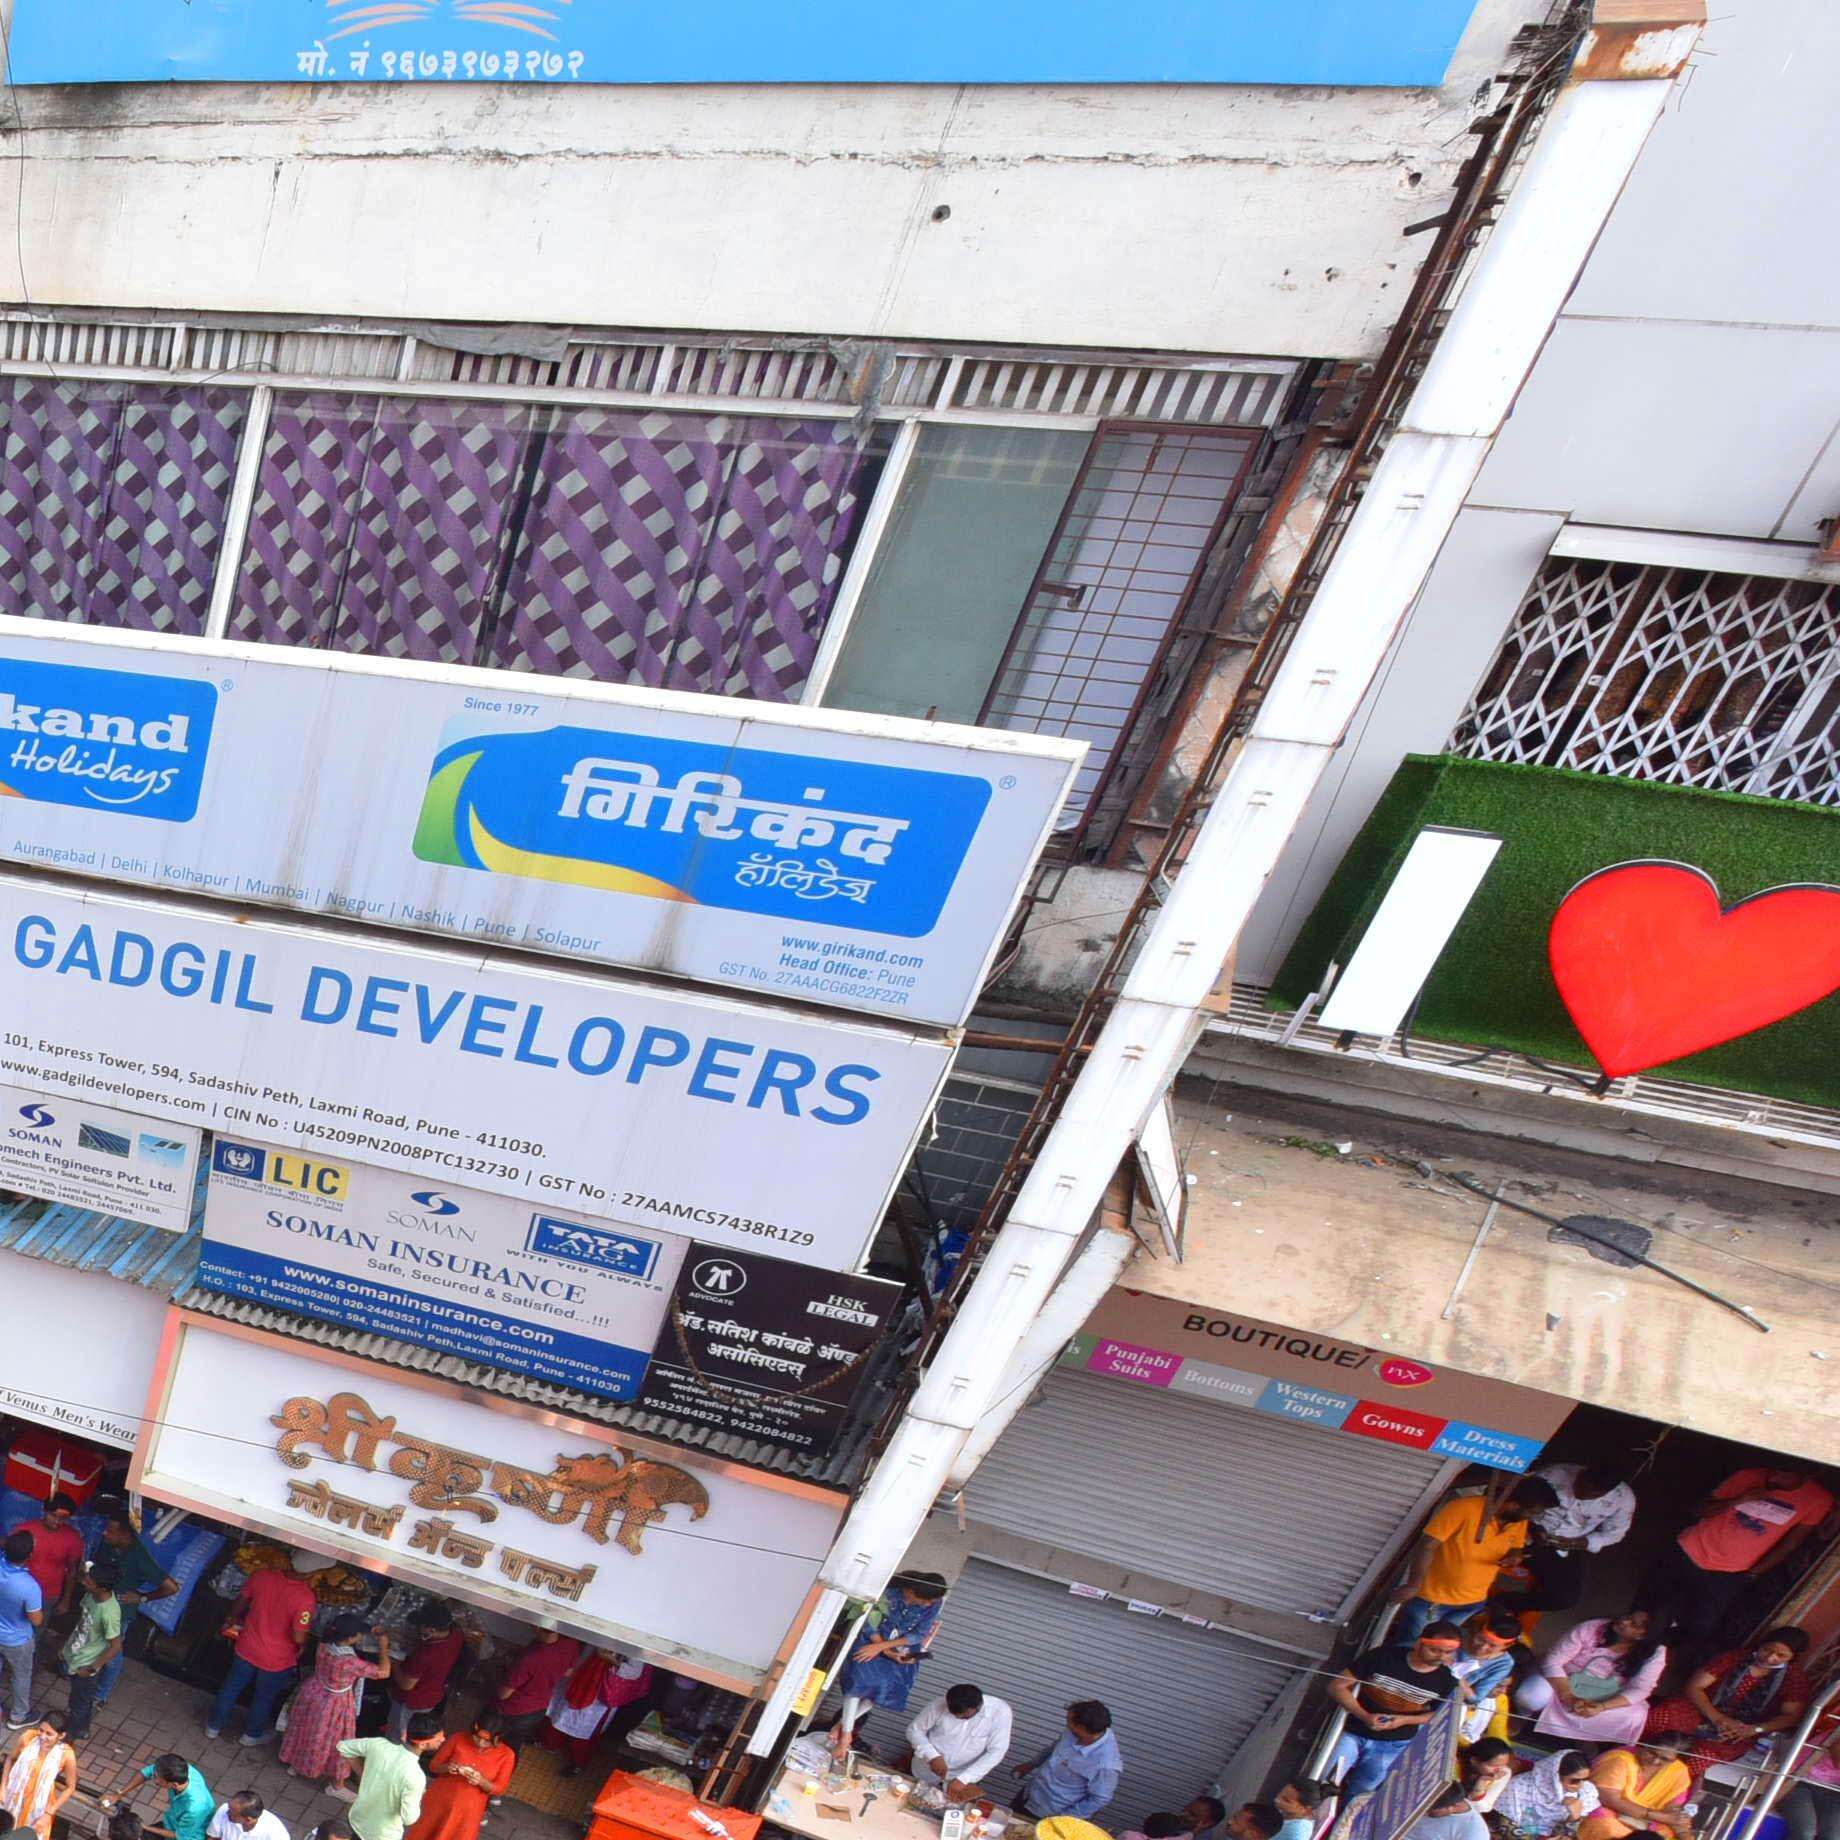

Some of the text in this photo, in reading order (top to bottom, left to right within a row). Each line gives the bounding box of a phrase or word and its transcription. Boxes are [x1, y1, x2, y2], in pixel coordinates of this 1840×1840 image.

[296, 40, 335, 77] मो.
[349, 41, 370, 77] नं
[463, 696, 540, 718] Since 1977
[10, 738, 180, 802] Holidays
[557, 755, 910, 866] गिरिकंद
[13, 840, 602, 952] Aurangabad Delhi Kolhapur Mumbai Nagpur Nashik Pune Solapur
[781, 934, 925, 969] www.girikand.com
[719, 962, 748, 978] GST
[779, 952, 917, 988] Head Office: Pune
[14, 914, 883, 1126] GADGIL DEVELOPERS
[3, 1032, 548, 1159] 101, Express Tower, 594, Sadashiv Peth, Laxmi Road, Pune 411030.
[0, 1059, 207, 1114] www.gadgildevelopers.com
[223, 1106, 252, 1123] CIN
[255, 1112, 279, 1128] No
[538, 1174, 576, 1192] GST
[578, 1182, 606, 1201] No
[8, 1127, 63, 1149] SOMAN
[44, 1152, 114, 1178] Engineers
[117, 1170, 146, 1186] Pvt.
[149, 1177, 178, 1194] Ltd.
[272, 1157, 341, 1195] LIC
[386, 1210, 478, 1243] SOMAN
[547, 1223, 640, 1256] TATA
[199, 1259, 246, 1279] Contact:
[249, 1273, 268, 1286] +91
[266, 1209, 587, 1305] SOMAN INSURANCE
[506, 1248, 664, 1292] WITH YOU ALWAYS
[367, 1257, 497, 1299] Safe, Secured &
[283, 1264, 556, 1345] www.somaninsurance.com
[688, 1290, 735, 1307] ADVOCATE
[809, 1302, 877, 1328] LEGAL
[826, 1294, 869, 1313] HSK
[260, 1288, 305, 1309] Express
[371, 1317, 425, 1340] Sadashiv
[533, 1362, 566, 1379] Pune
[575, 1373, 621, 1394] 411030
[1105, 1343, 1174, 1371] Punjabi
[1109, 1358, 1153, 1379] Suits
[1183, 1368, 1255, 1398] Bottoms
[1275, 1381, 1348, 1411] Western
[1281, 1398, 1323, 1420] Tops
[5, 1391, 48, 1414] Venus
[52, 1405, 97, 1428] Men's
[98, 1419, 138, 1441] Wear
[1361, 1412, 1426, 1439] Gowns
[1434, 1437, 1527, 1472] Materials
[1462, 1429, 1517, 1453] Dress
